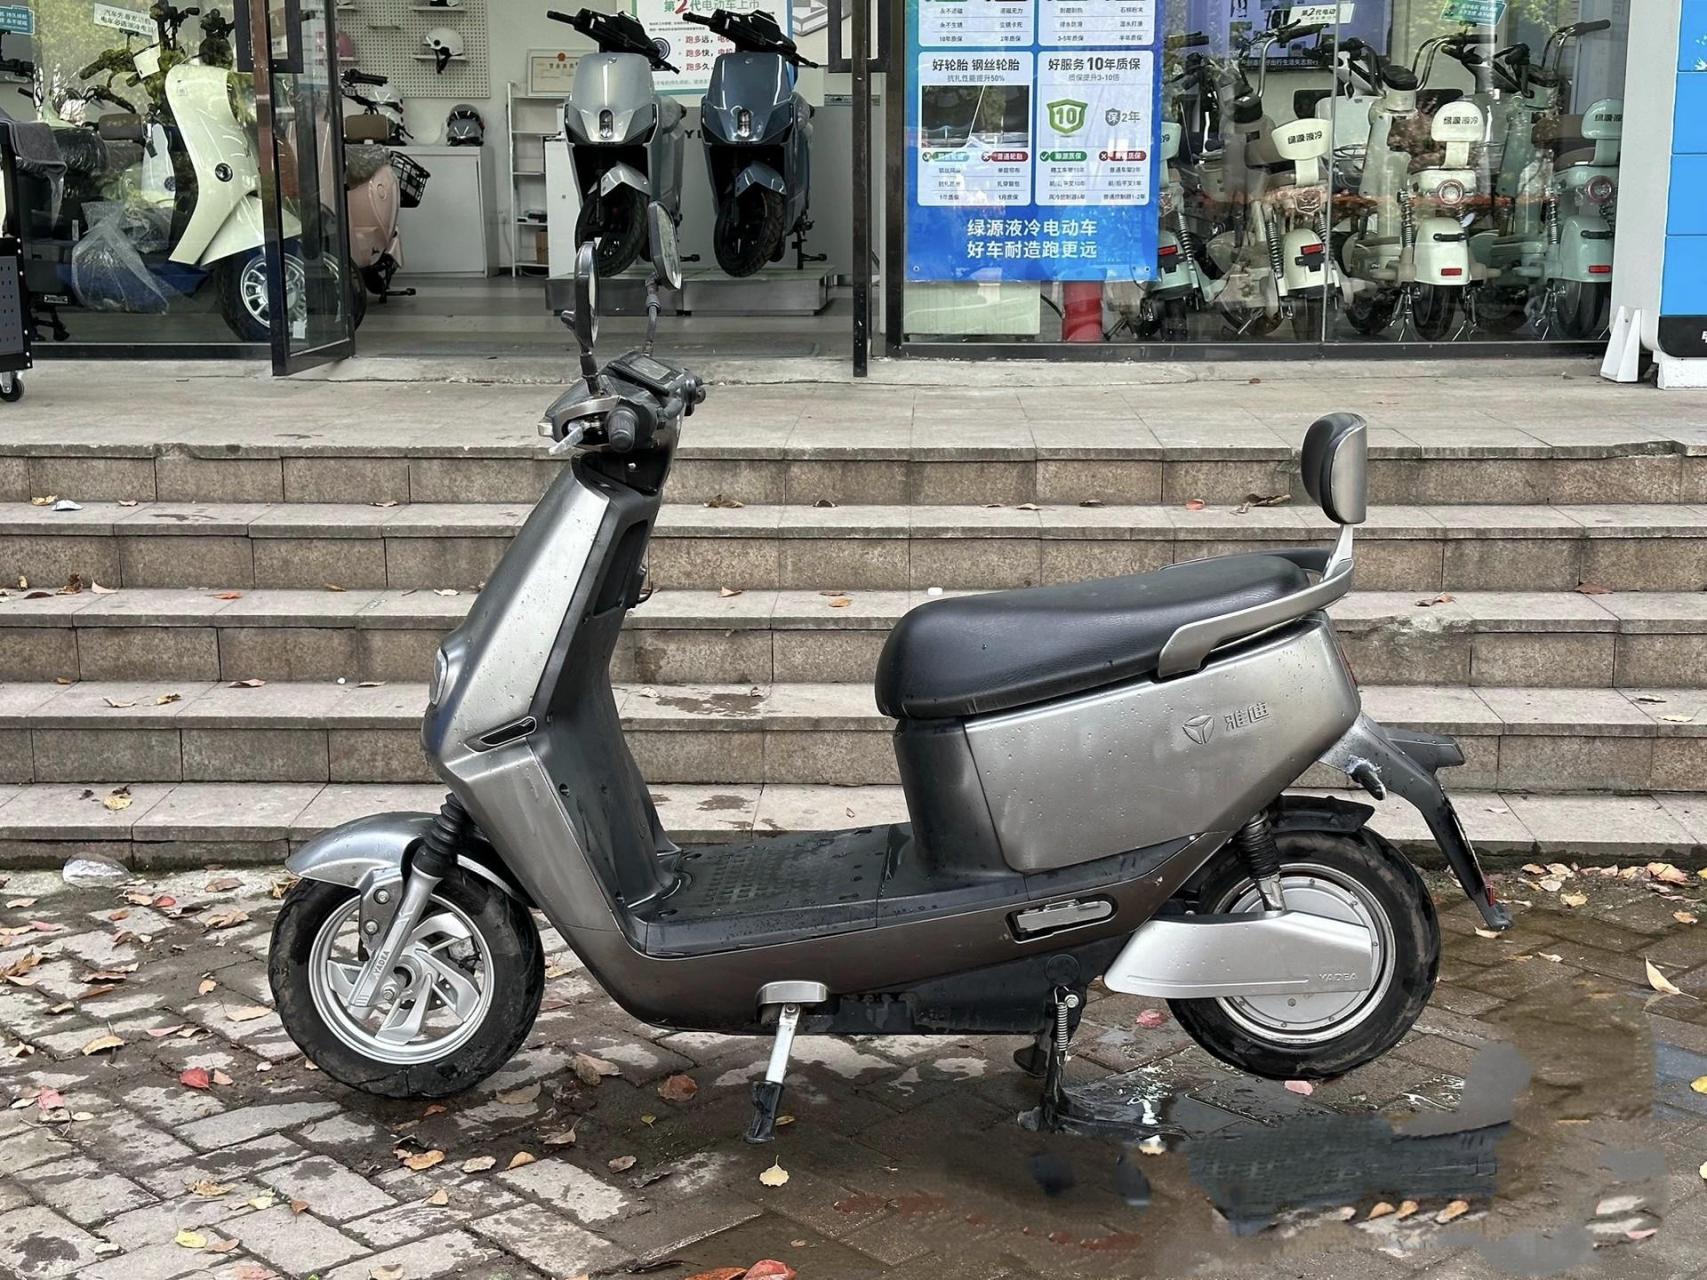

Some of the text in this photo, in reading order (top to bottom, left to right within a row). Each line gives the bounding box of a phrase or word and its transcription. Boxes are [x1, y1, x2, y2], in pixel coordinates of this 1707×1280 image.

[932, 58, 1020, 71] 好轮胎 钢丝轮胎
[1048, 57, 1141, 71] 好服务 10年质保
[1056, 107, 1077, 124] 10
[1121, 111, 1141, 123] 2年
[967, 219, 1098, 237] 绿源液冷电动车
[967, 240, 1097, 258] 好车耐造跑更远
